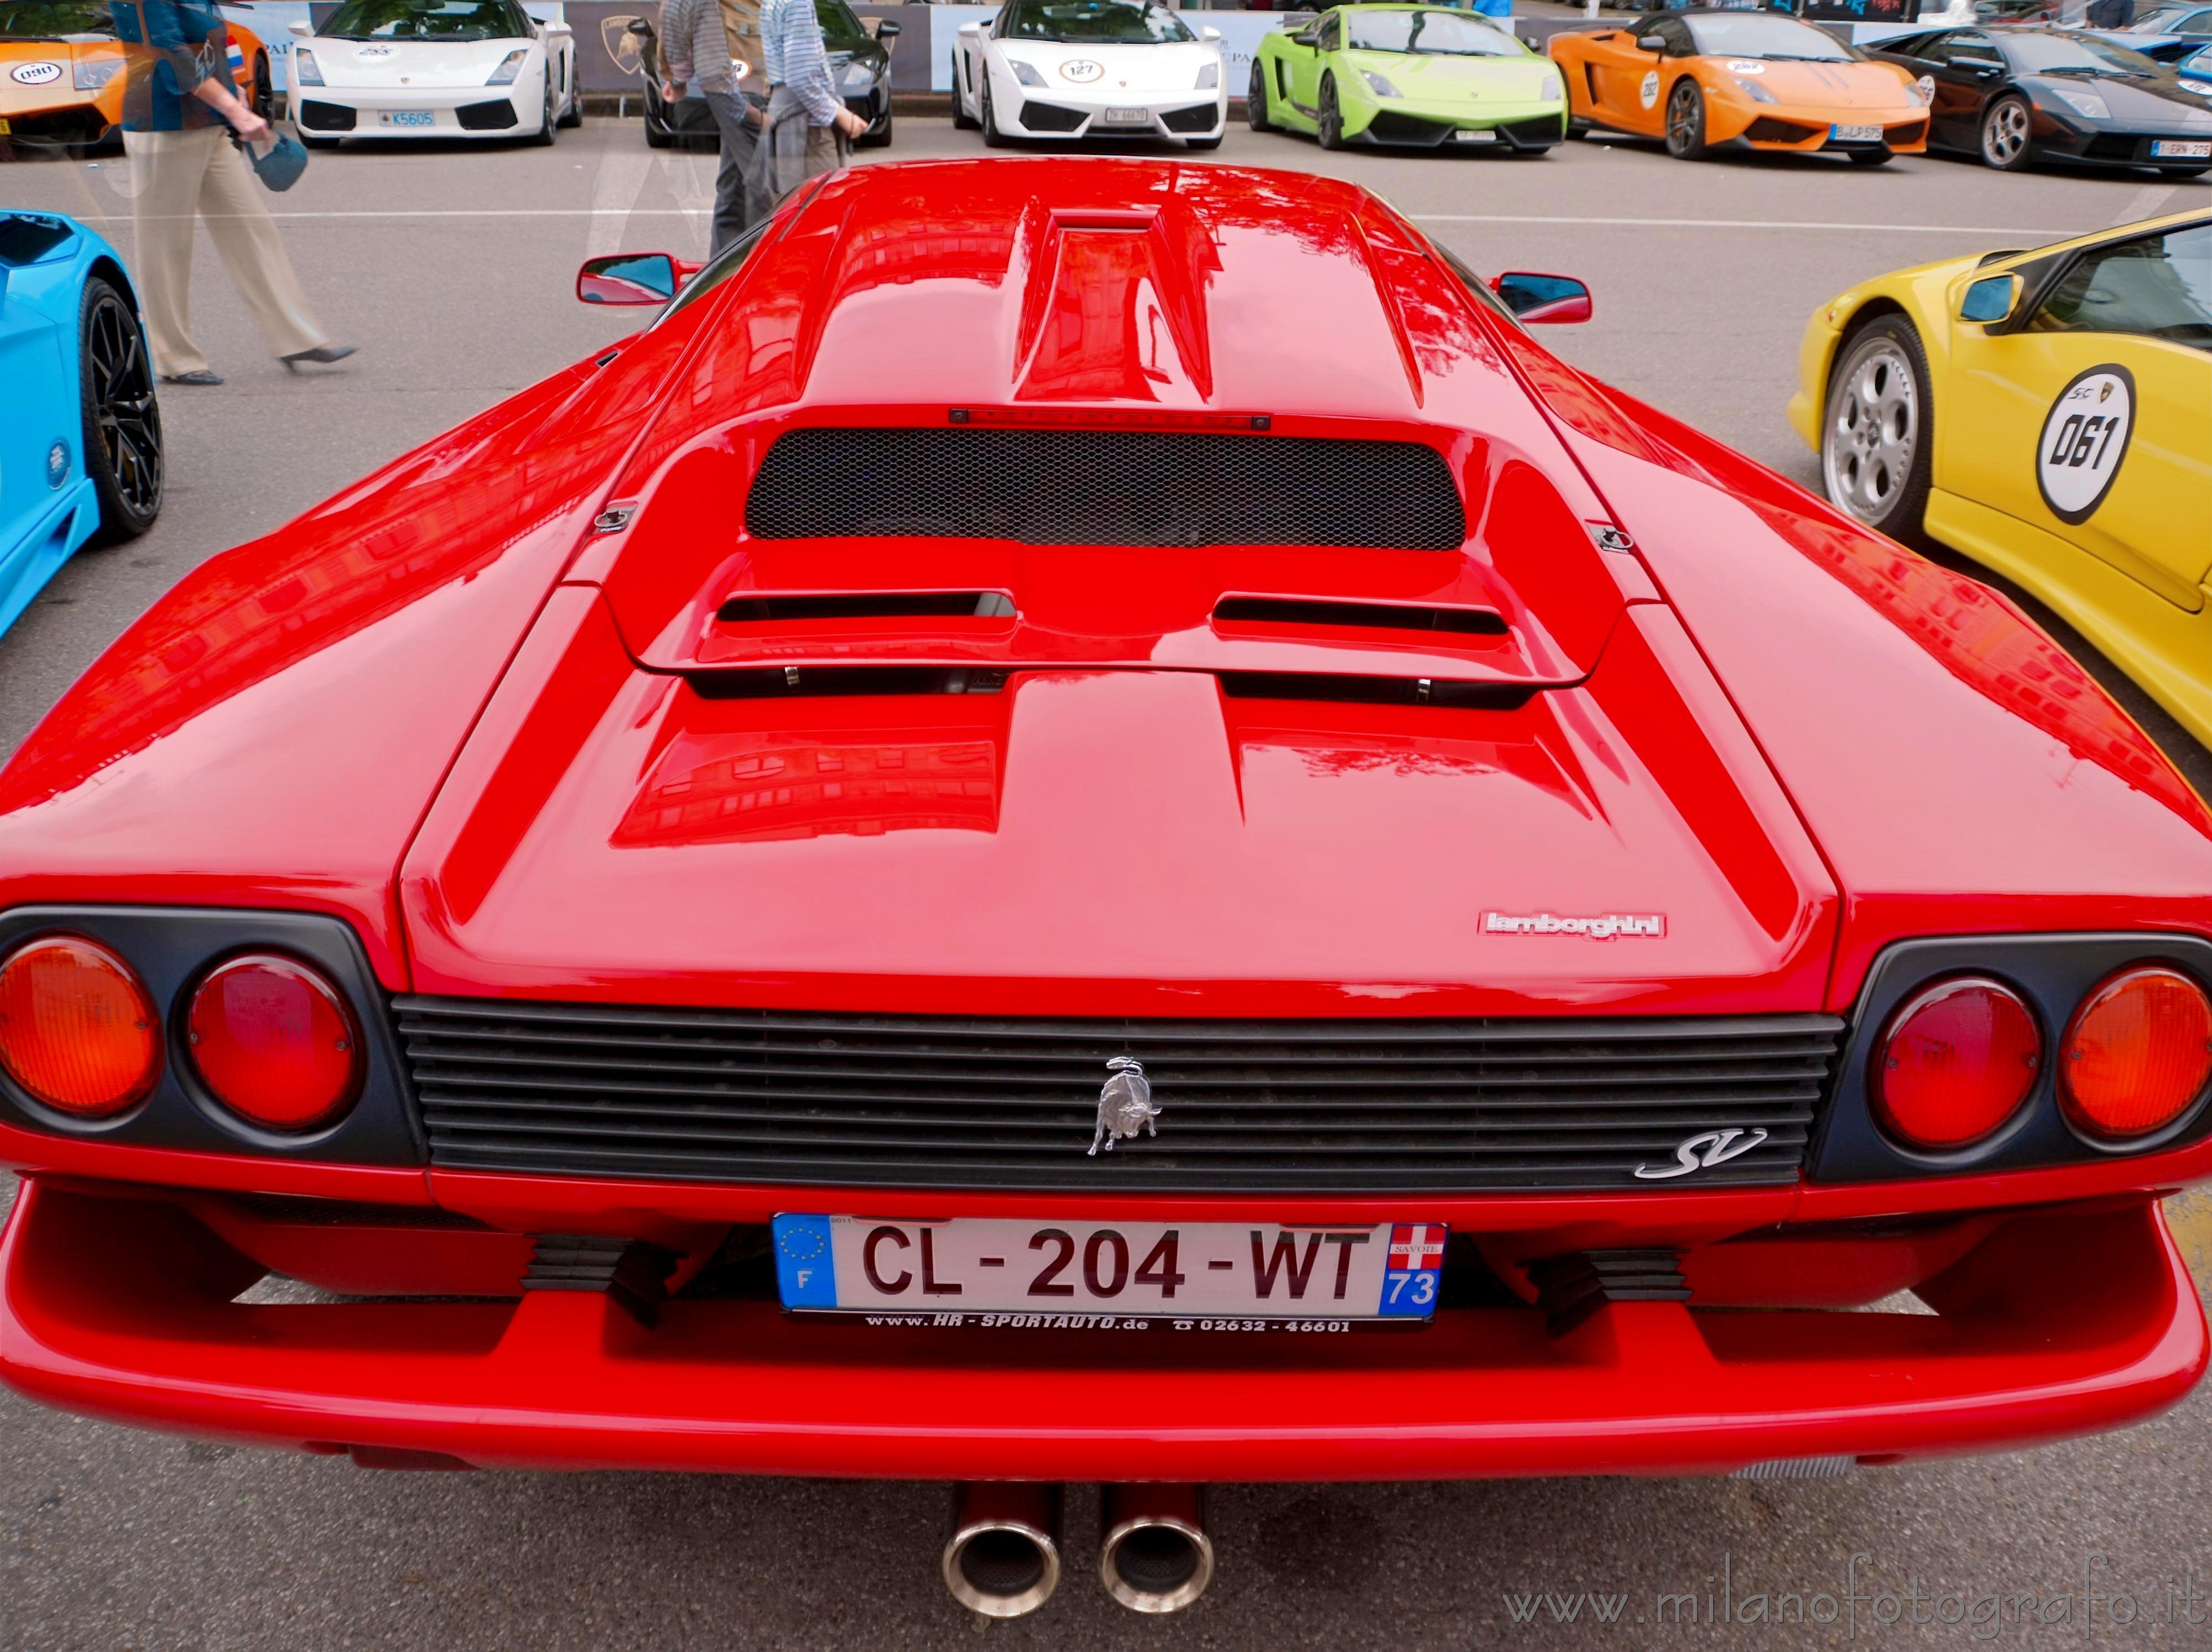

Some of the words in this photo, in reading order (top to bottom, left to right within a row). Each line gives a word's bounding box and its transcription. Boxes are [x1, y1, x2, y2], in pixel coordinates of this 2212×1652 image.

[1070, 65, 1094, 75] 127
[392, 112, 433, 125] K5605
[1865, 126, 1882, 138] 575
[2049, 414, 2121, 470] 061
[1634, 1128, 1768, 1179] SV
[797, 1270, 813, 1289] F
[1388, 1273, 1434, 1304] 73
